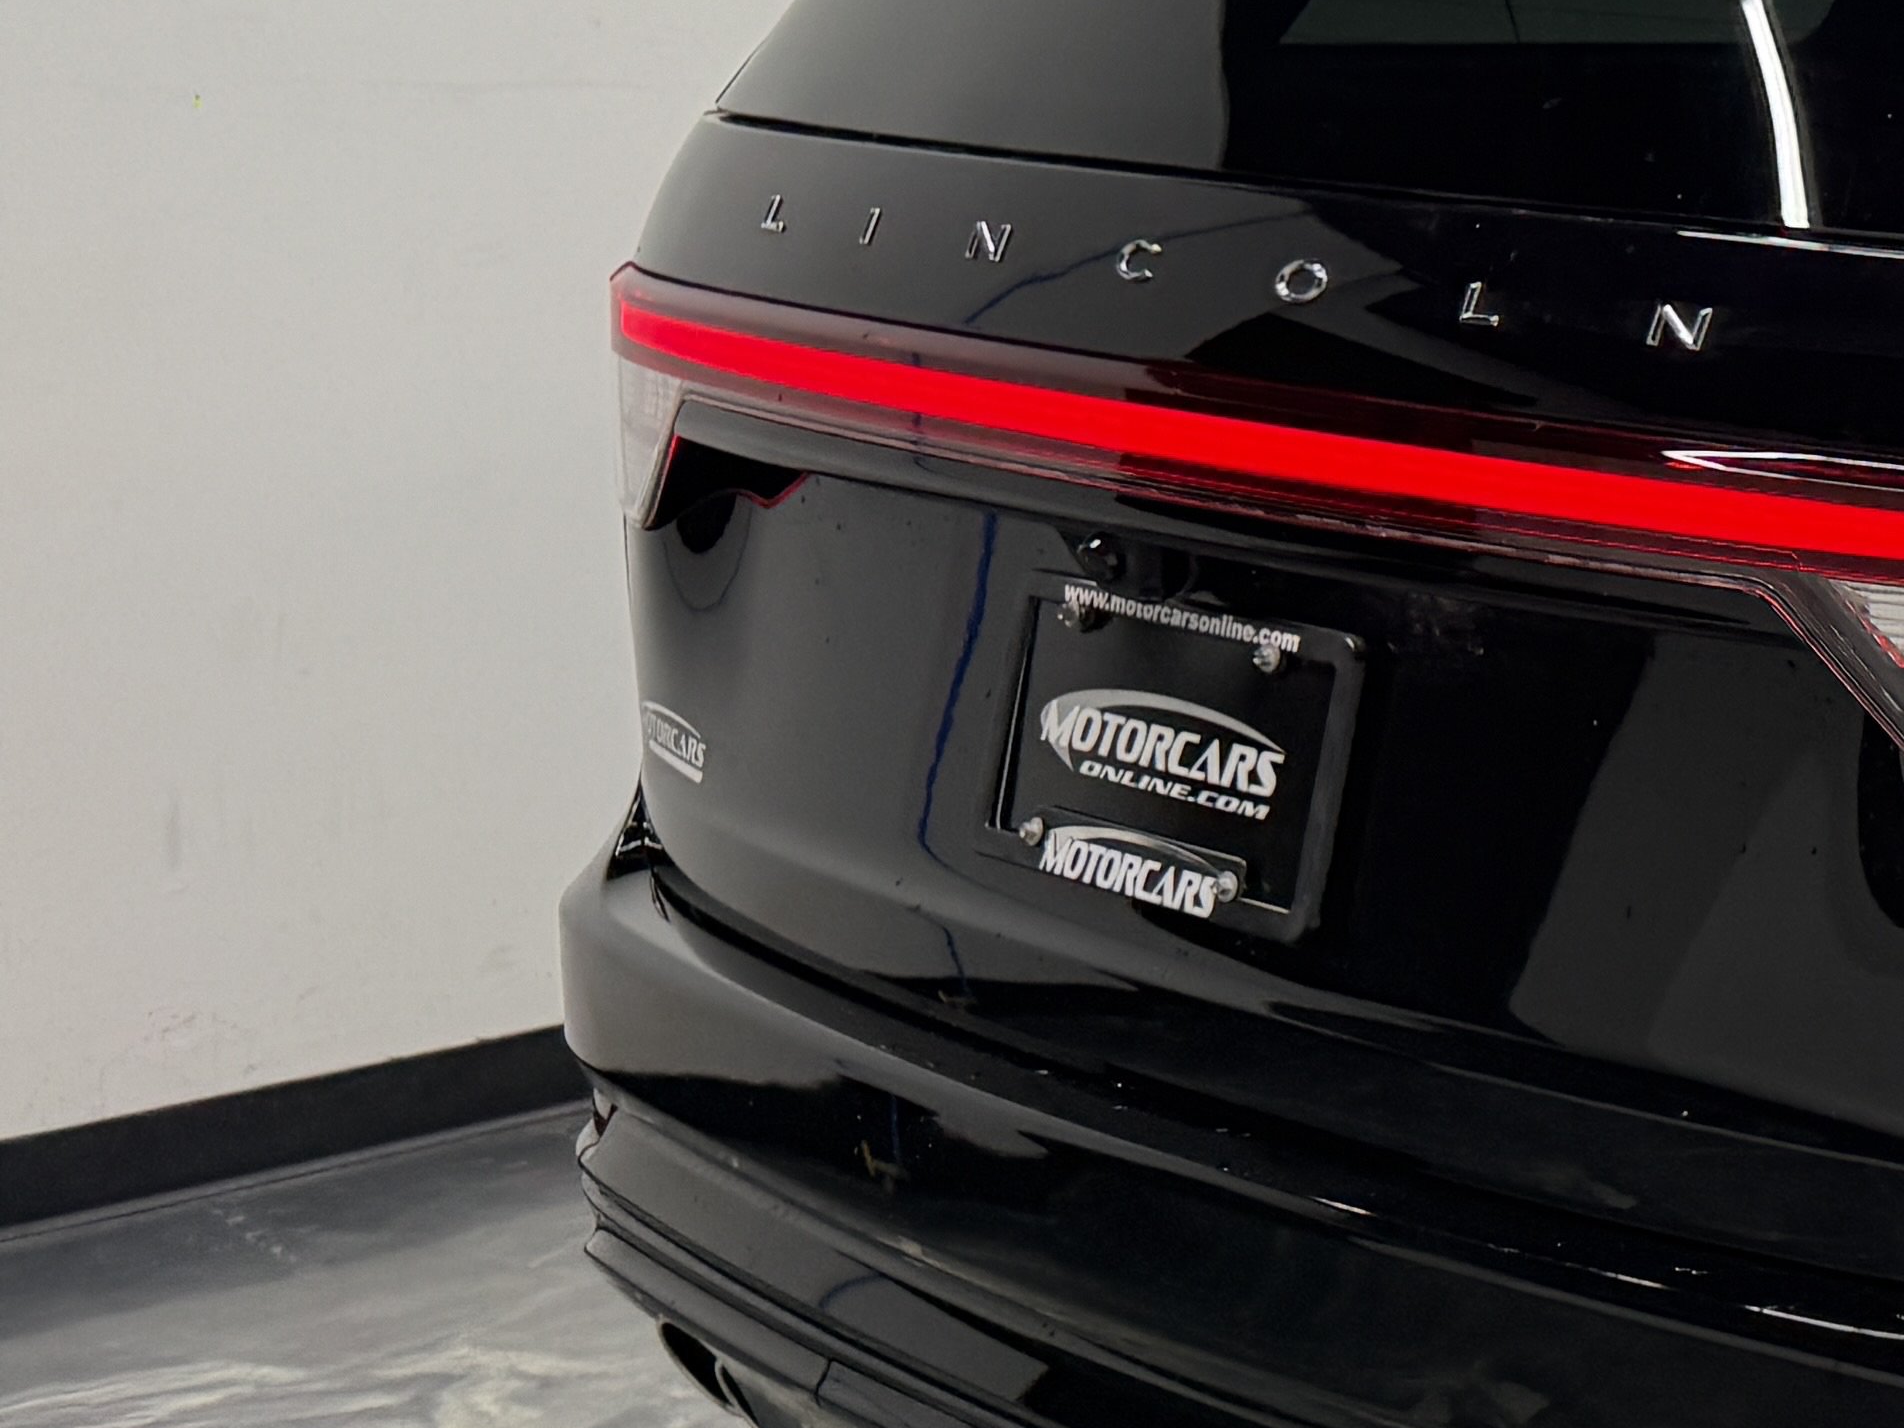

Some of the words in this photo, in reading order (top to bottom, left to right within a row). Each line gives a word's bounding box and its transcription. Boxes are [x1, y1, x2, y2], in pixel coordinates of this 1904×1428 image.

[760, 194, 1714, 351] LINCOLN
[1064, 584, 1300, 653] www.motorcarsonline.com
[1040, 700, 1286, 798] MOTORCARS
[1079, 760, 1271, 821] ONLINE.COM
[1038, 831, 1218, 919] MOTORCARS
